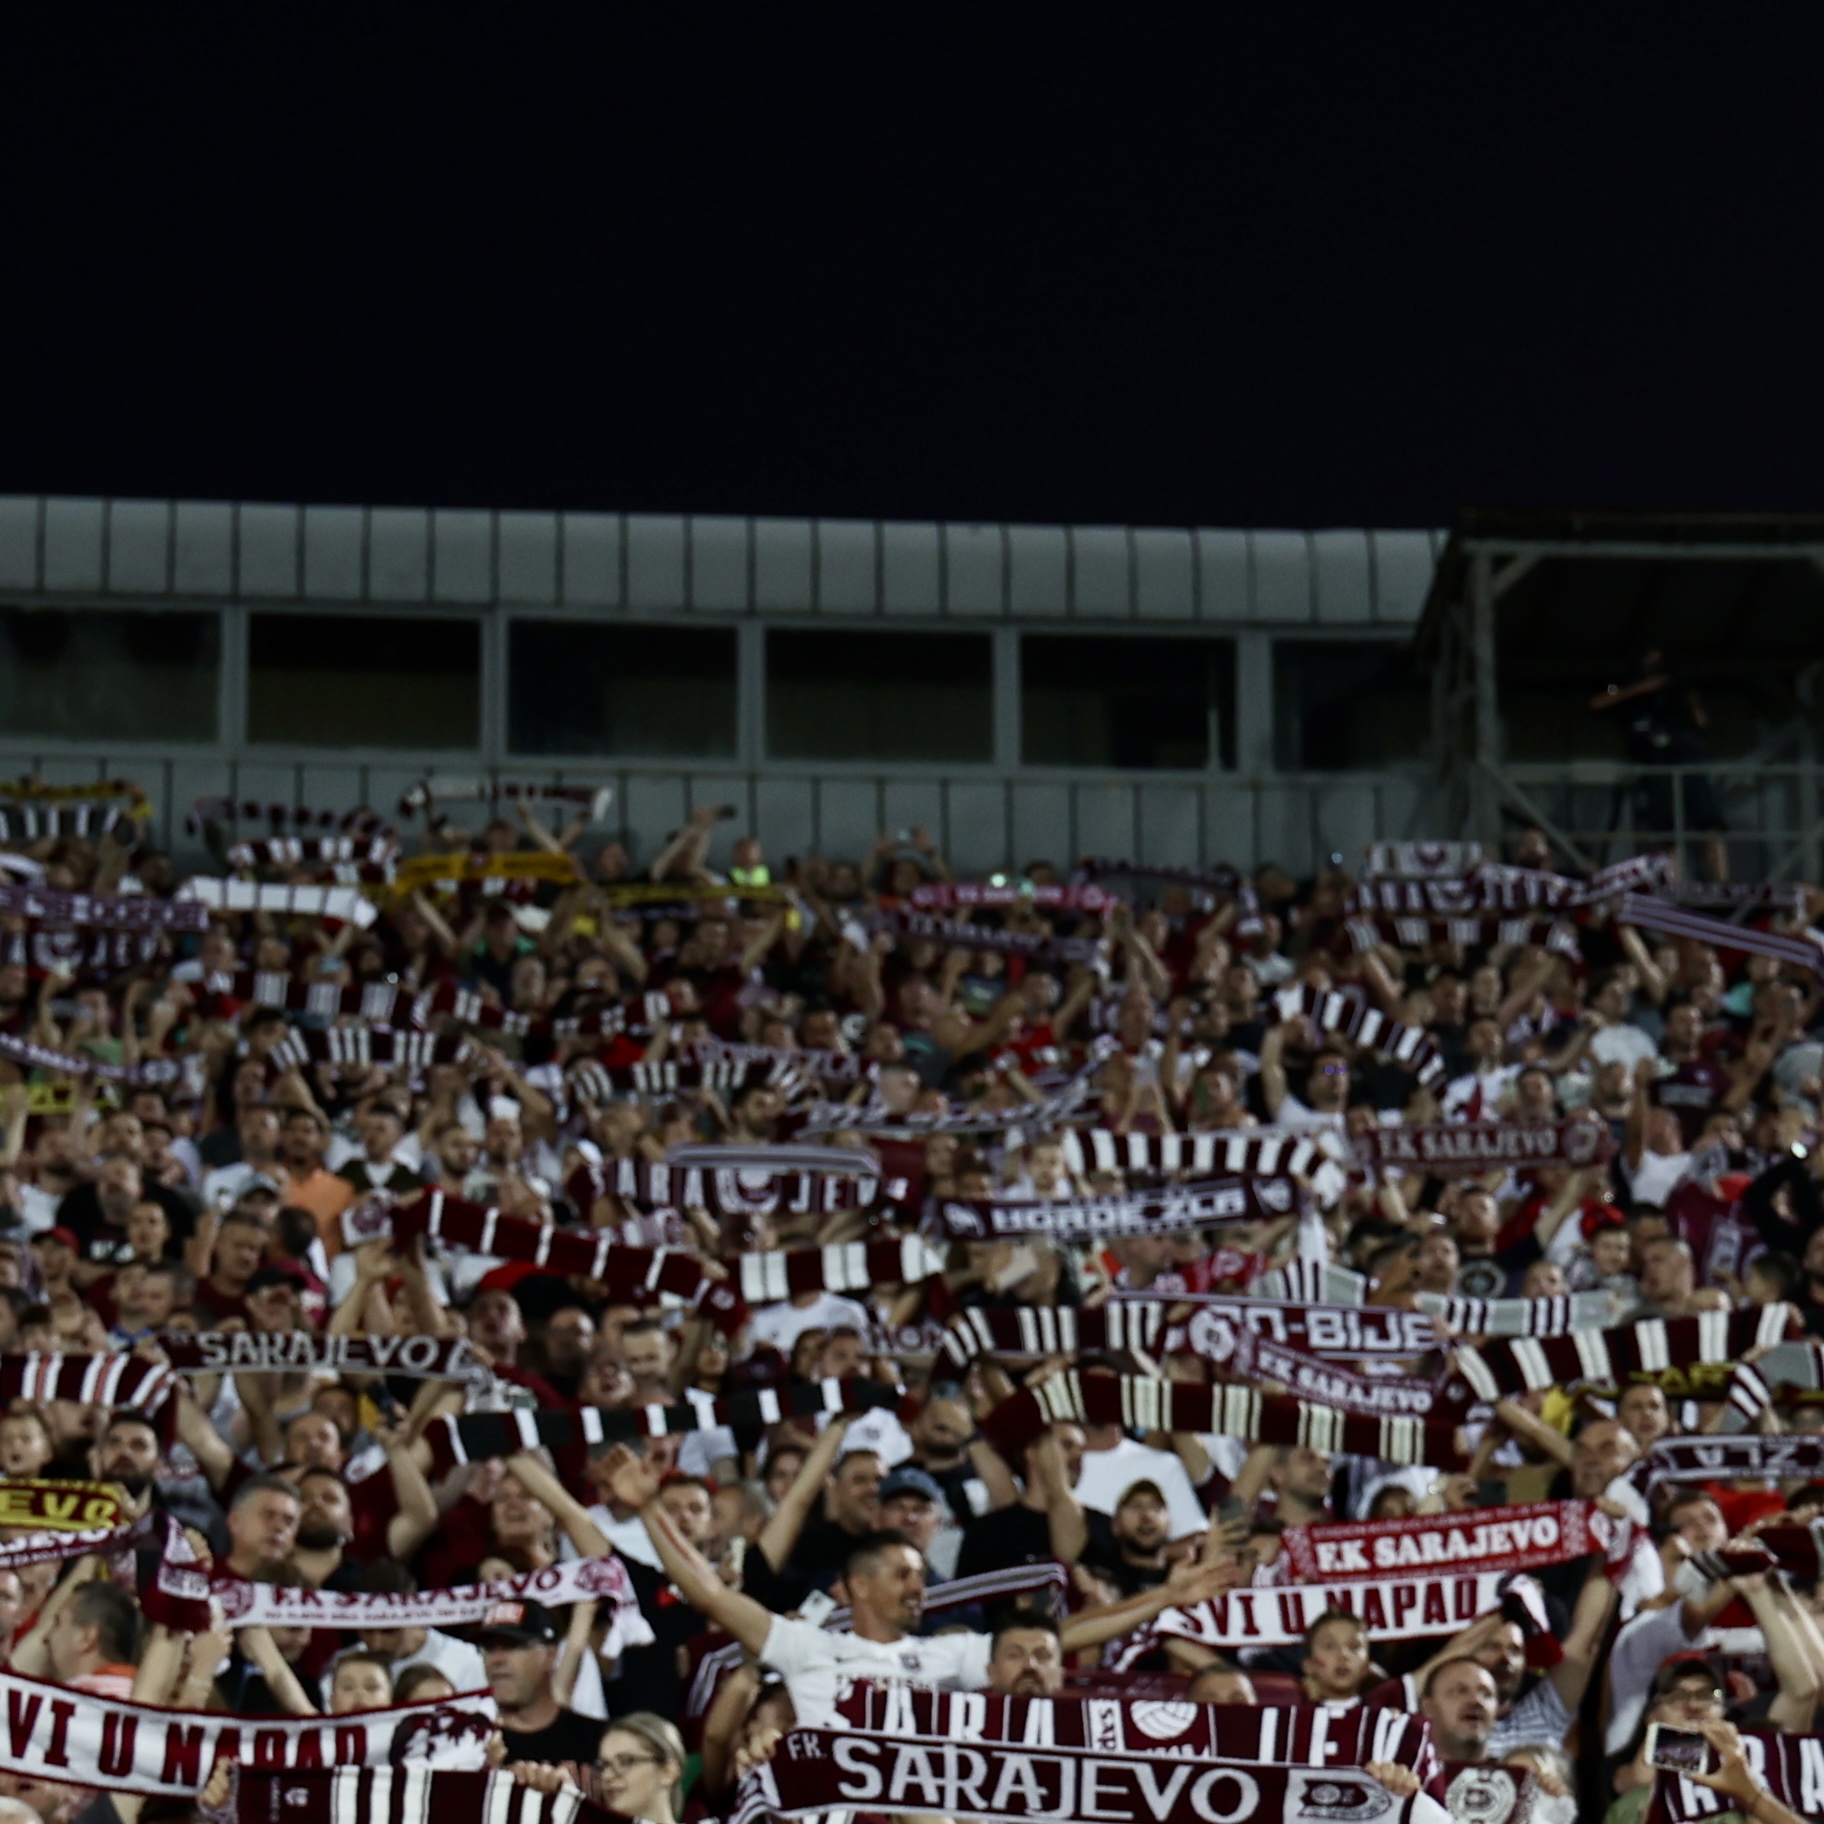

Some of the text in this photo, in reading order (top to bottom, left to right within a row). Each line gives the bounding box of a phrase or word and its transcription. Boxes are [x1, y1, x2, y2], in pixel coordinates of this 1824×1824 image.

[197, 1331, 440, 1371] SARAJEVO
[1374, 1513, 1562, 1570] SARAJEVO
[1277, 1592, 1306, 1633] U
[98, 1707, 135, 1778] U
